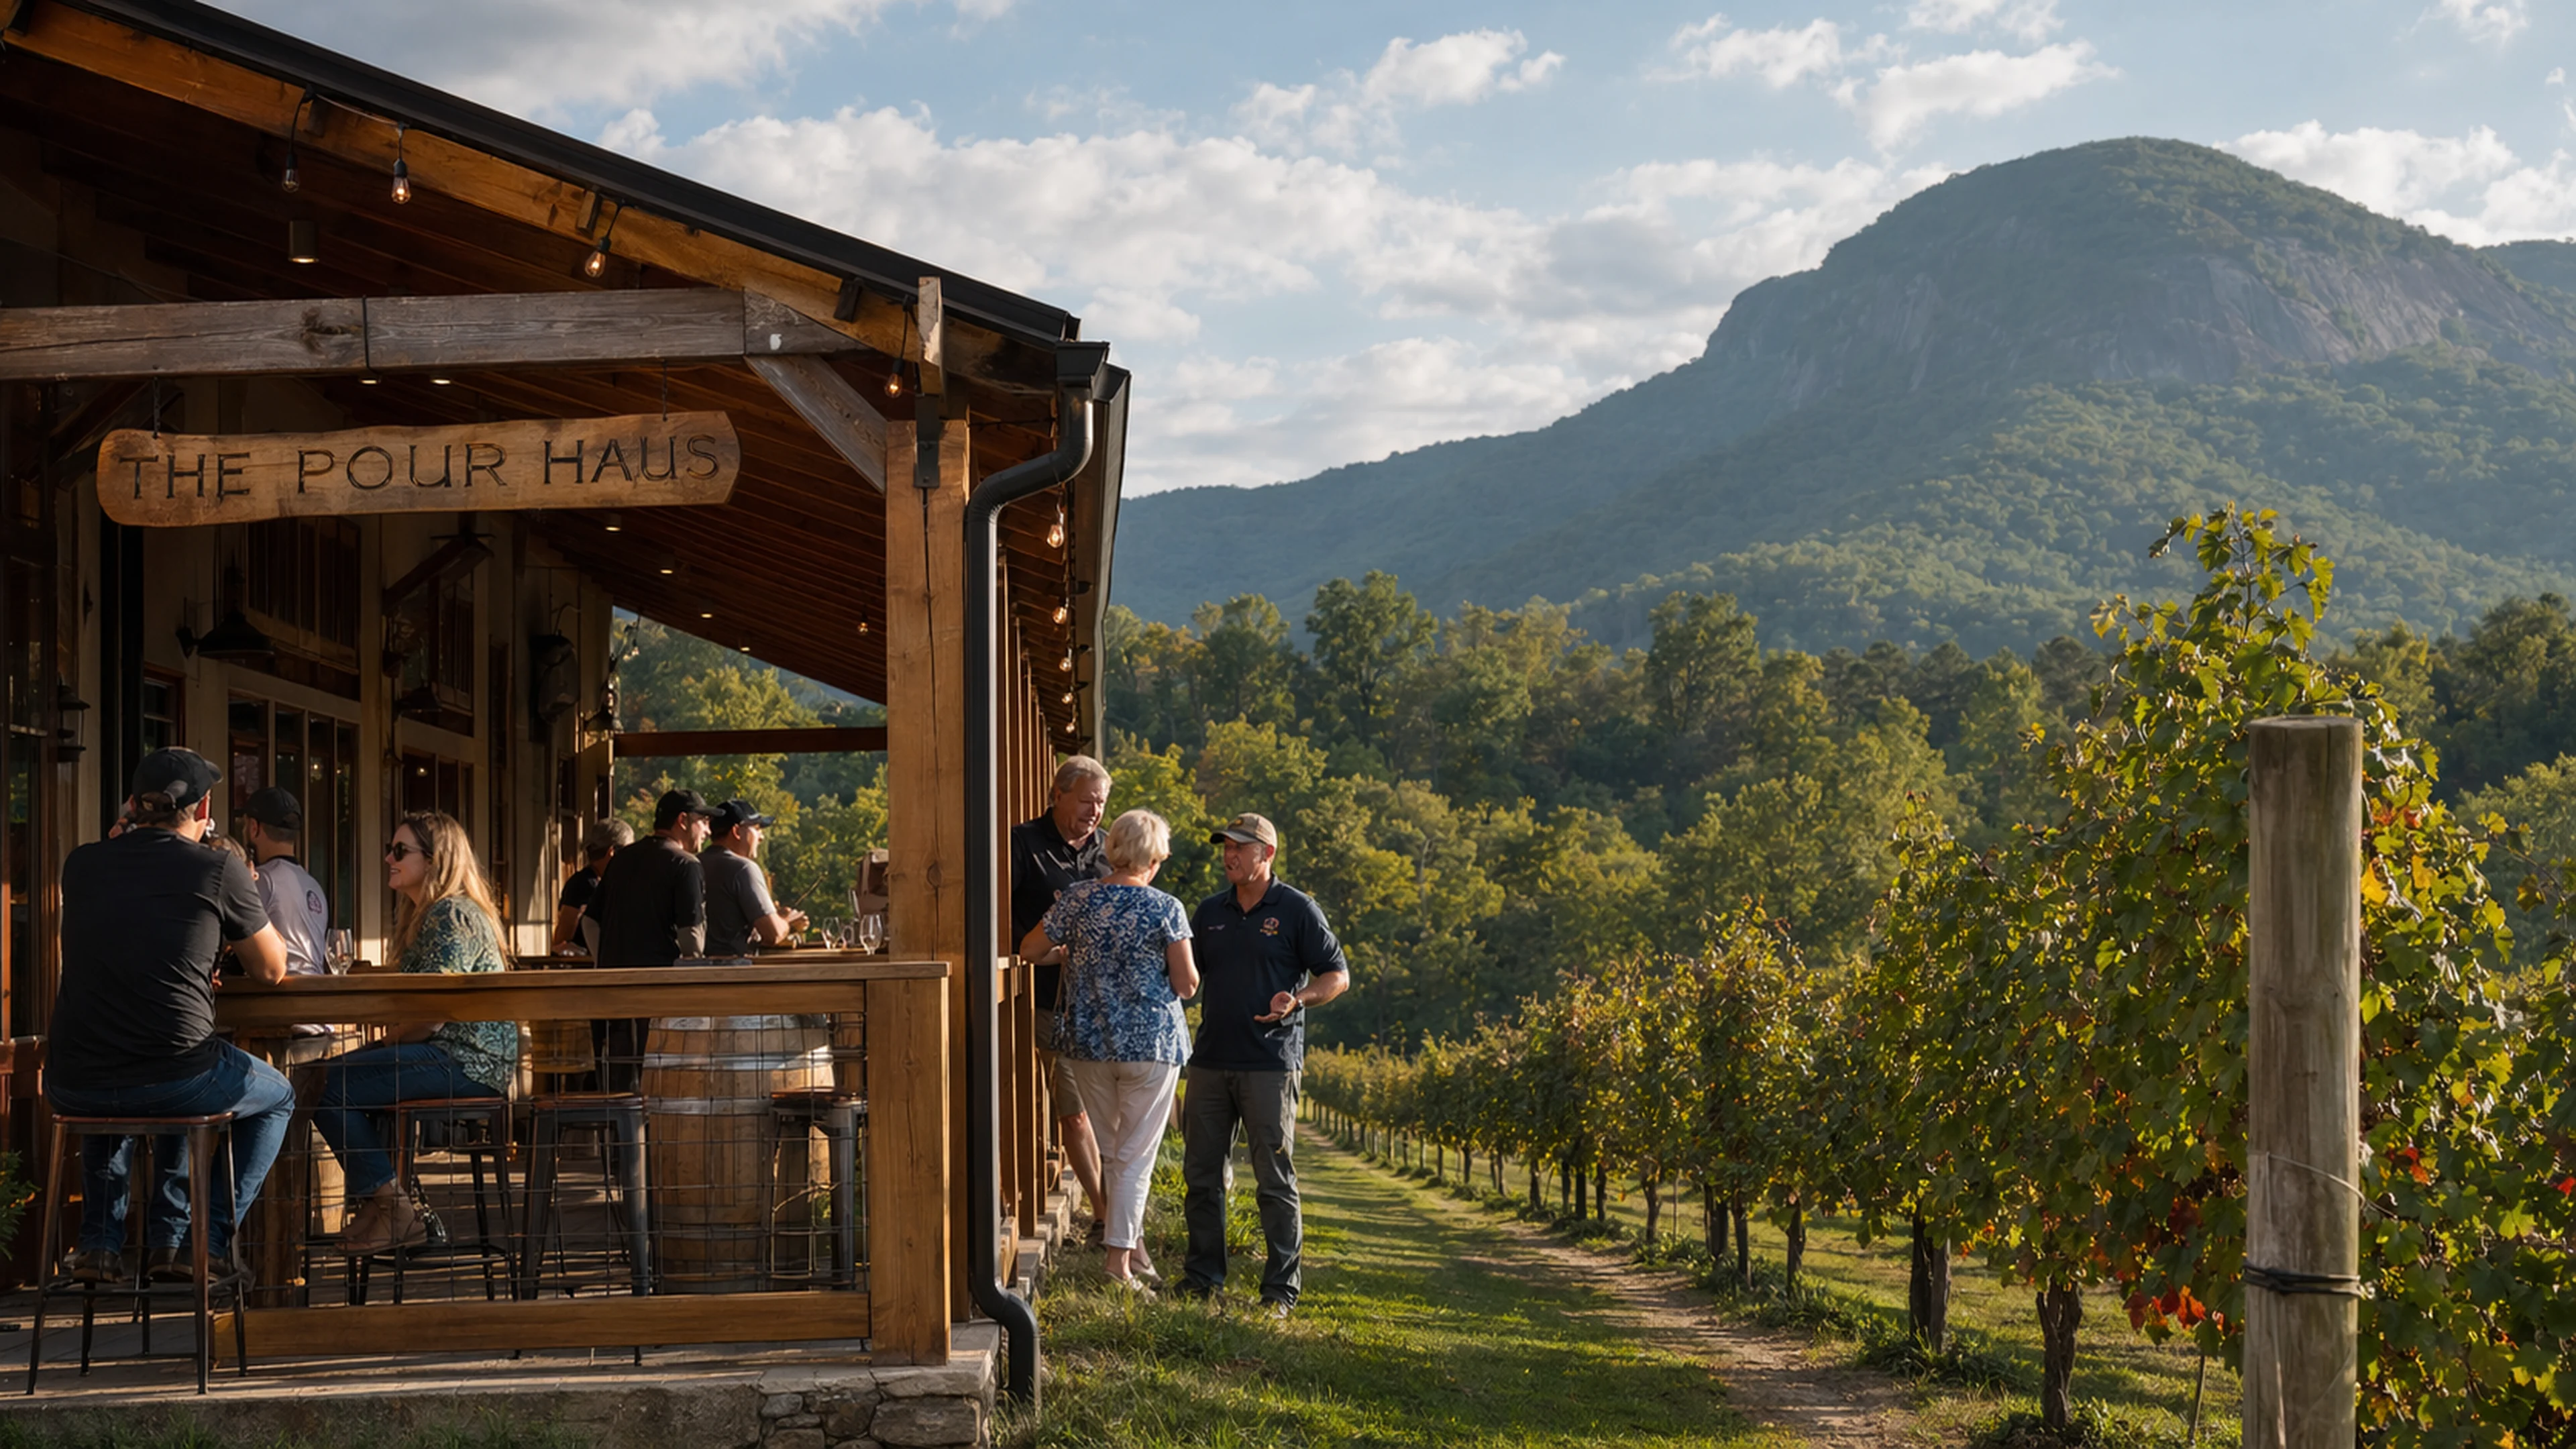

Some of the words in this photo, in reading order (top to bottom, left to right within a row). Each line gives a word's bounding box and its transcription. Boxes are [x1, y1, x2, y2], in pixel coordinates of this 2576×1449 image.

[119, 452, 250, 499] THE
[297, 443, 507, 494] POUR
[544, 435, 718, 484] HAUS
